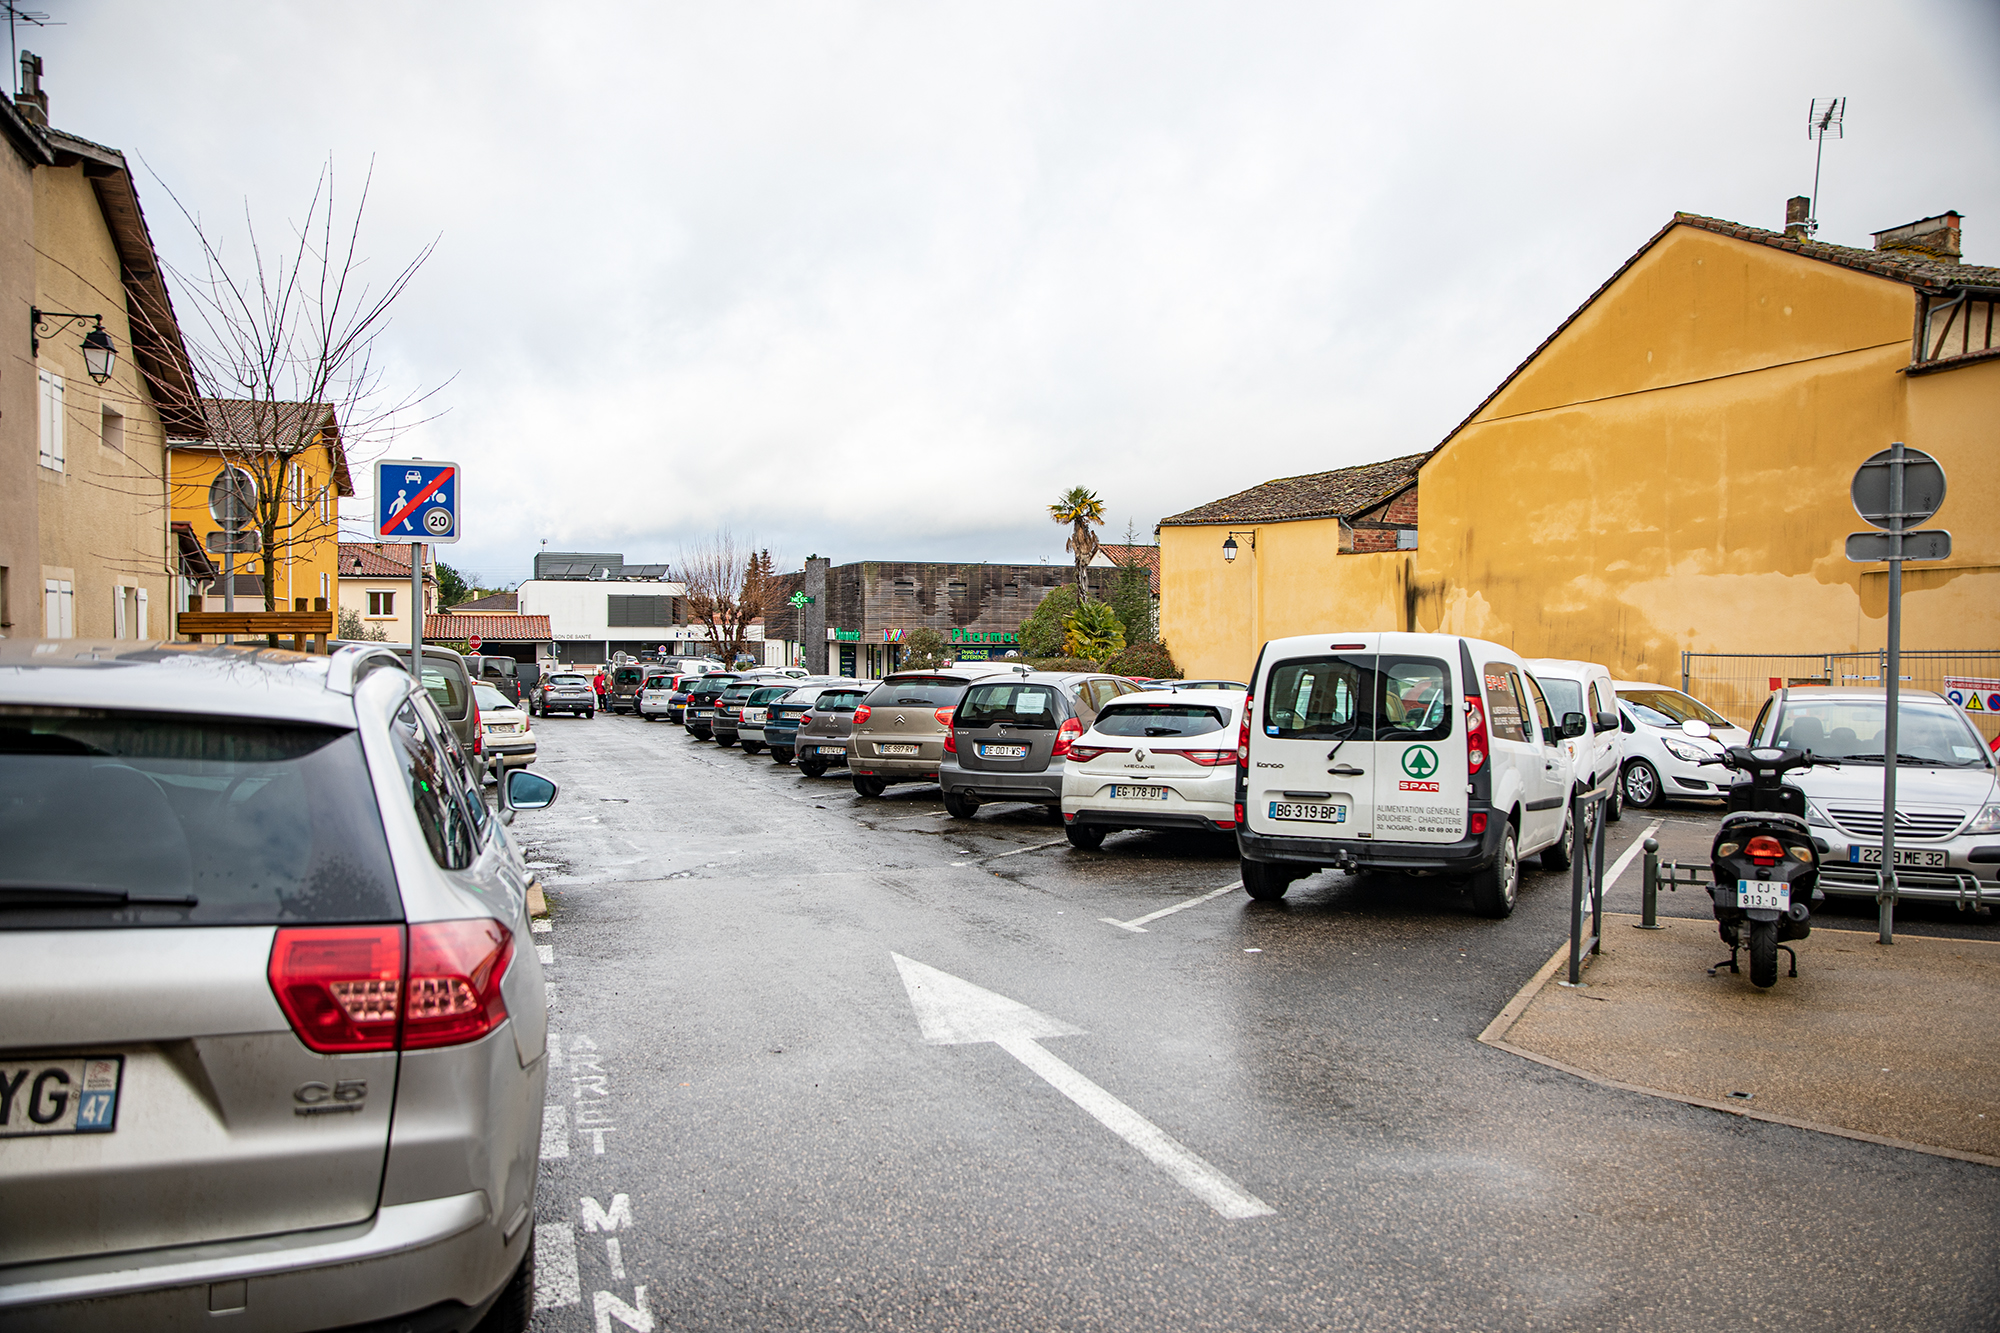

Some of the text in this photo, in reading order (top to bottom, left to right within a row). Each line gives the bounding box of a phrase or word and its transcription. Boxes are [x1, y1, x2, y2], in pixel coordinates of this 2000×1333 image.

[430, 516, 447, 527] 20
[952, 627, 1019, 643] Pharmac
[1399, 782, 1439, 791] SPAR
[1276, 804, 1337, 819] BG-319-BP
[1376, 804, 1460, 816] ALIMENTATION GÉNÉRALE
[1376, 814, 1412, 823] BOUCHERIE
[1417, 816, 1462, 826] CHARCUTERIE
[1864, 849, 1943, 866] 229 ME 32
[294, 1080, 367, 1104] C5
[81, 1094, 111, 1124] 47
